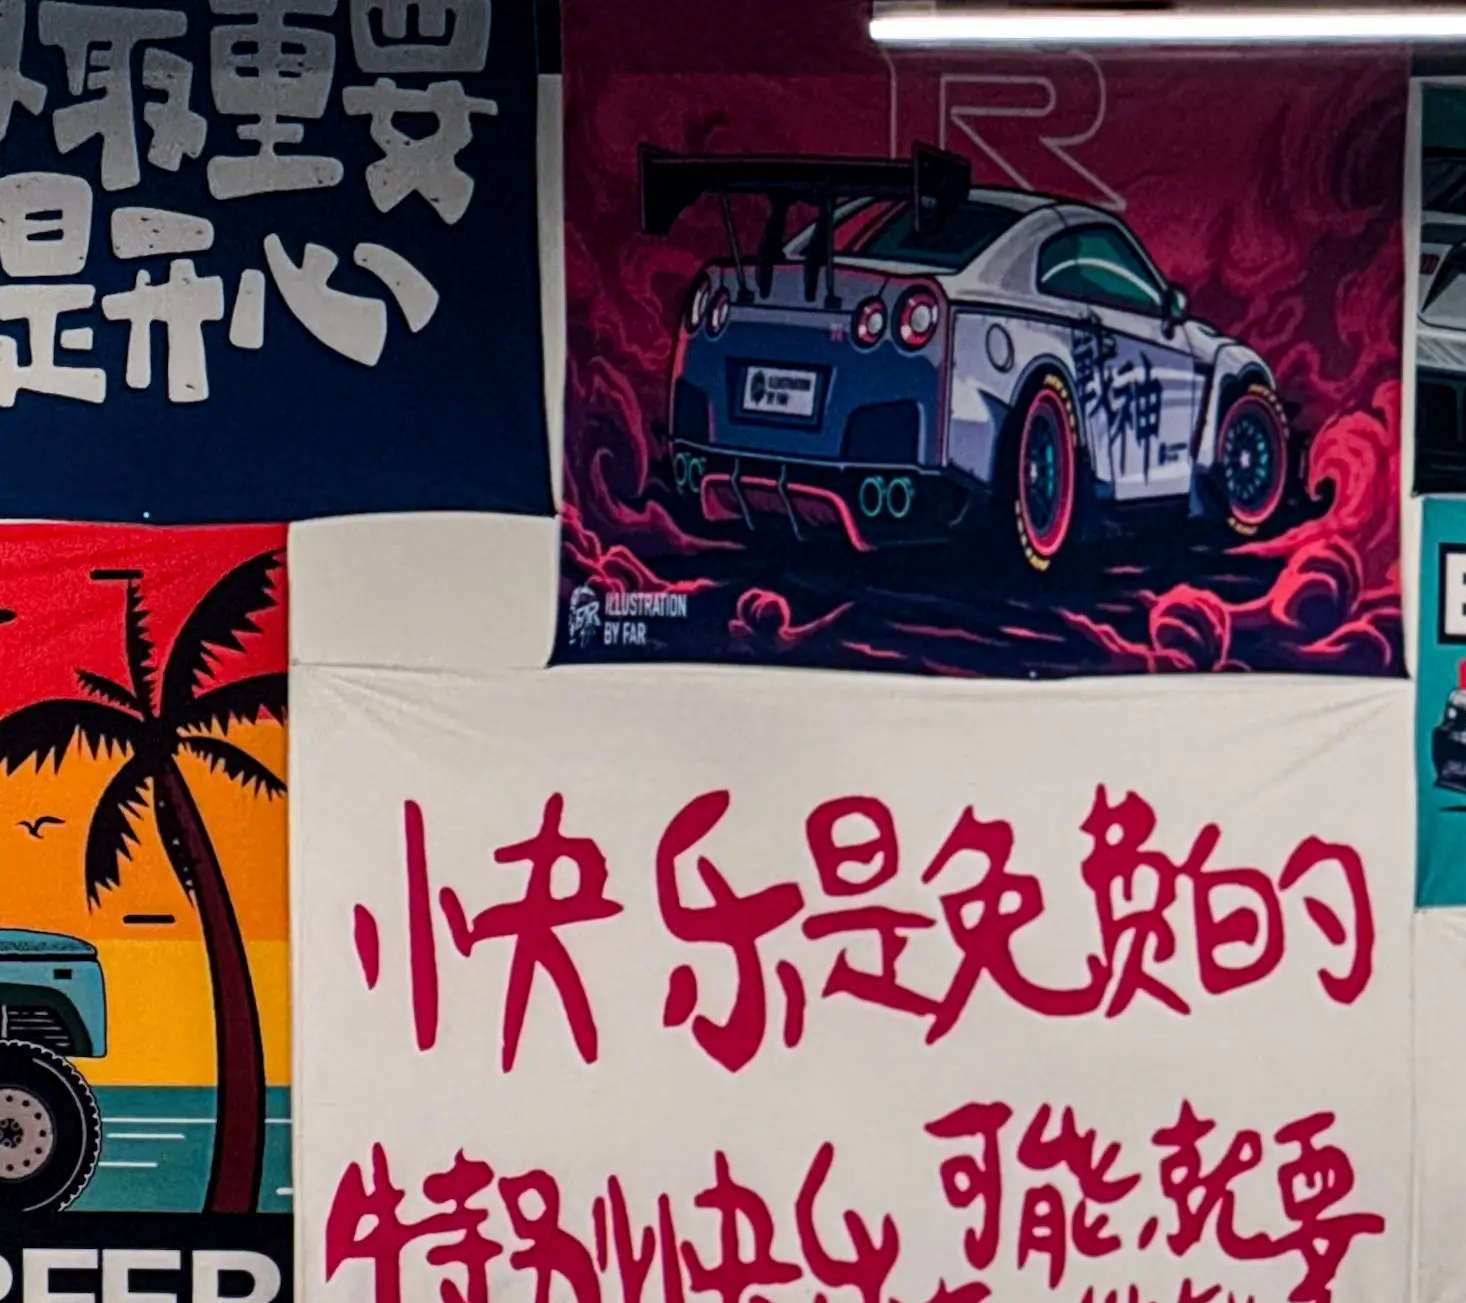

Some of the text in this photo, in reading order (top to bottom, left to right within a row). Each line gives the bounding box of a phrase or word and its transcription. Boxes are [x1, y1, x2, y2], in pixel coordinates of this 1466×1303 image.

[0, 0, 498, 225] 最重要
[604, 591, 687, 618] ILLUSTRATION
[604, 621, 647, 645] BY FAR
[353, 784, 1377, 1075] 快乐是免费的
